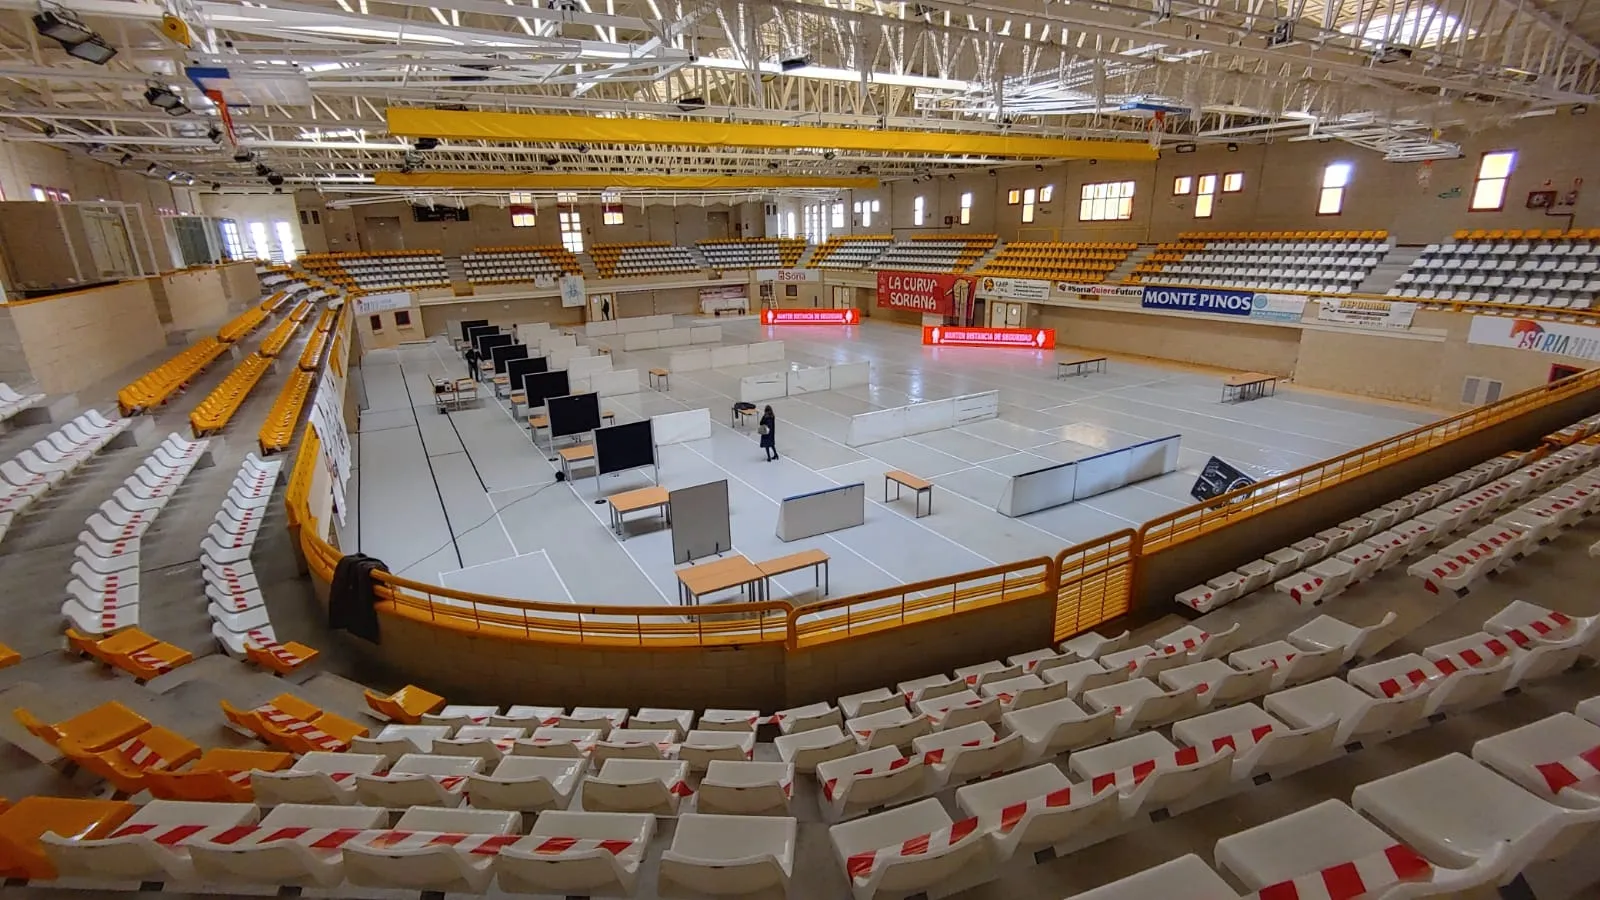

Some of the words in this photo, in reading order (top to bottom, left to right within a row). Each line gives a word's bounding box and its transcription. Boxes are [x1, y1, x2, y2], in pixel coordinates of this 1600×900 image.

[785, 272, 806, 280] Soria
[888, 276, 901, 290] LA
[1067, 285, 1142, 296] #SoriaQuiereFuturo
[890, 292, 937, 310] SORIANA
[1144, 291, 1197, 307] MONTE
[1199, 293, 1252, 310] PINOS
